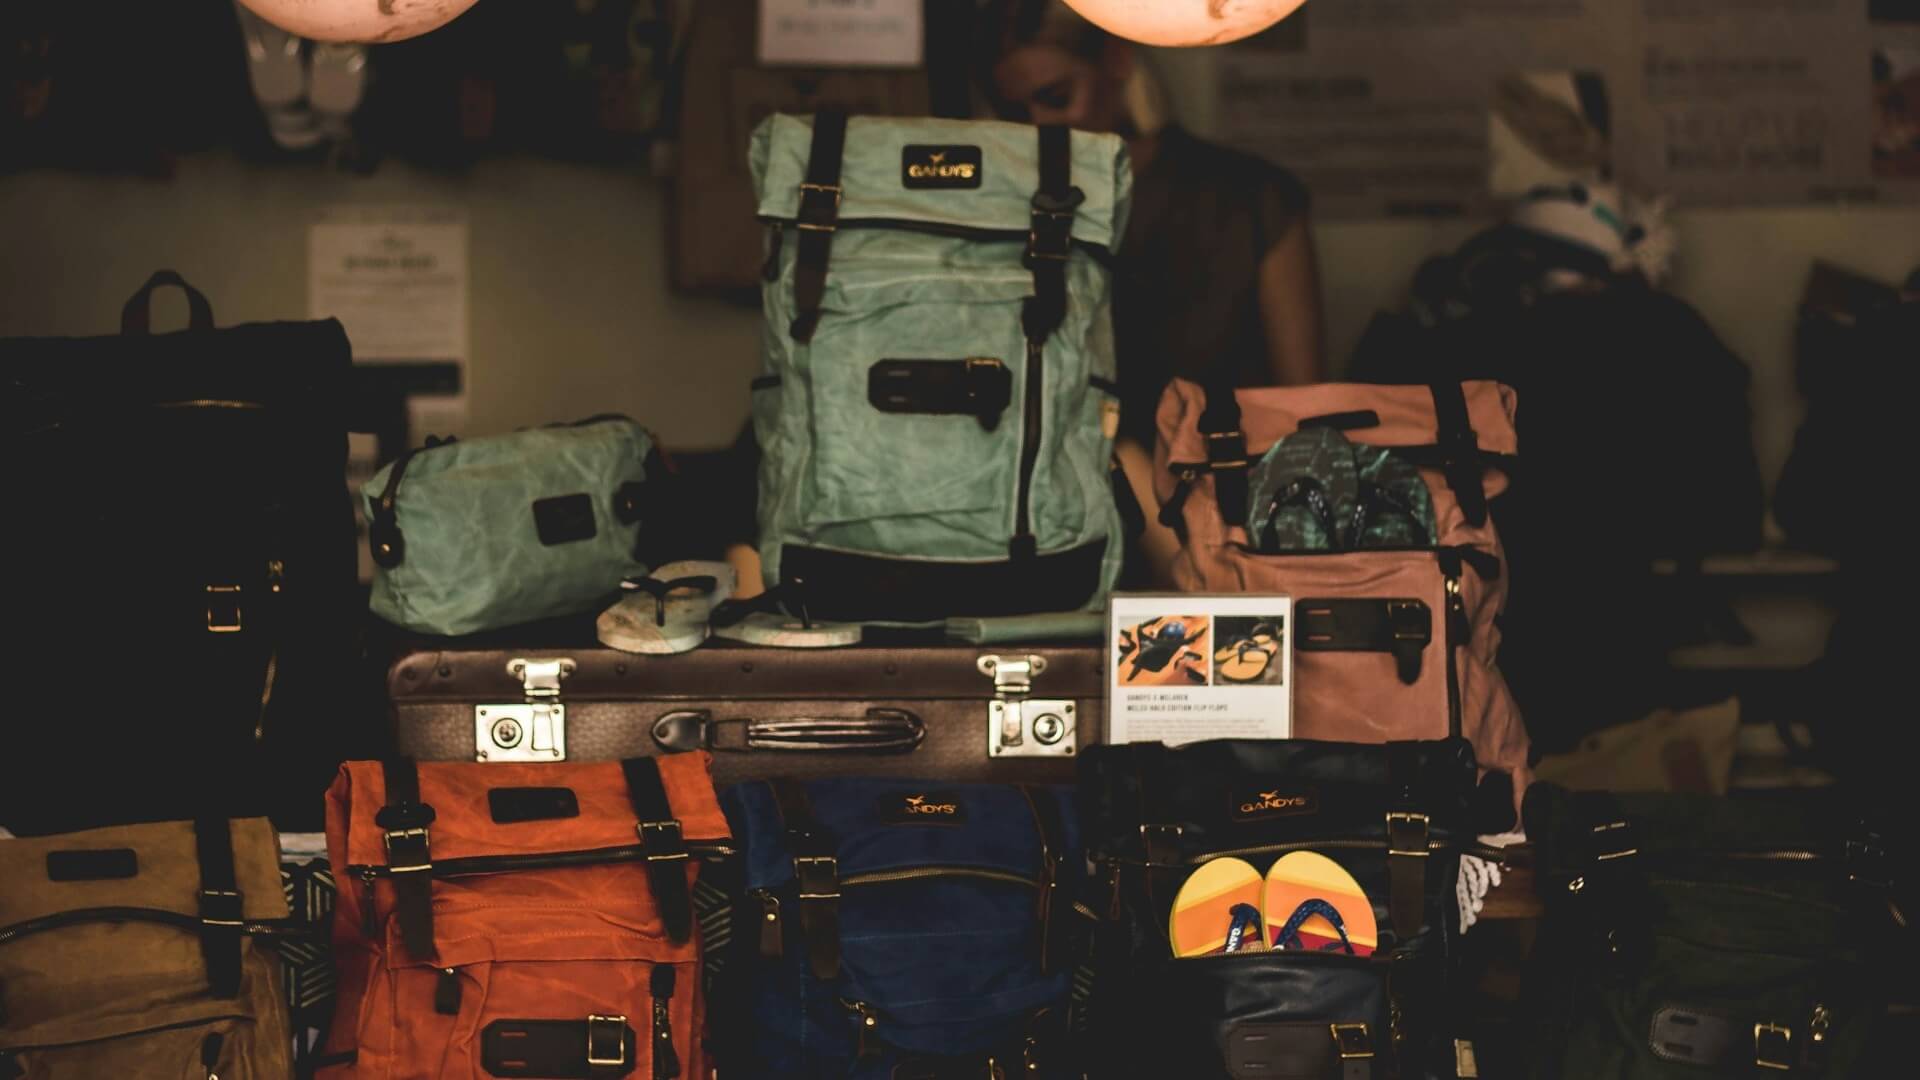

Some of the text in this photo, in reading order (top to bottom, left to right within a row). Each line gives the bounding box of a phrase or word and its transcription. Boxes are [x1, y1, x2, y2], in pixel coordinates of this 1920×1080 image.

[908, 163, 976, 178] GANDYS
[905, 804, 956, 814] ANDYS
[1240, 797, 1305, 813] GANDYS
